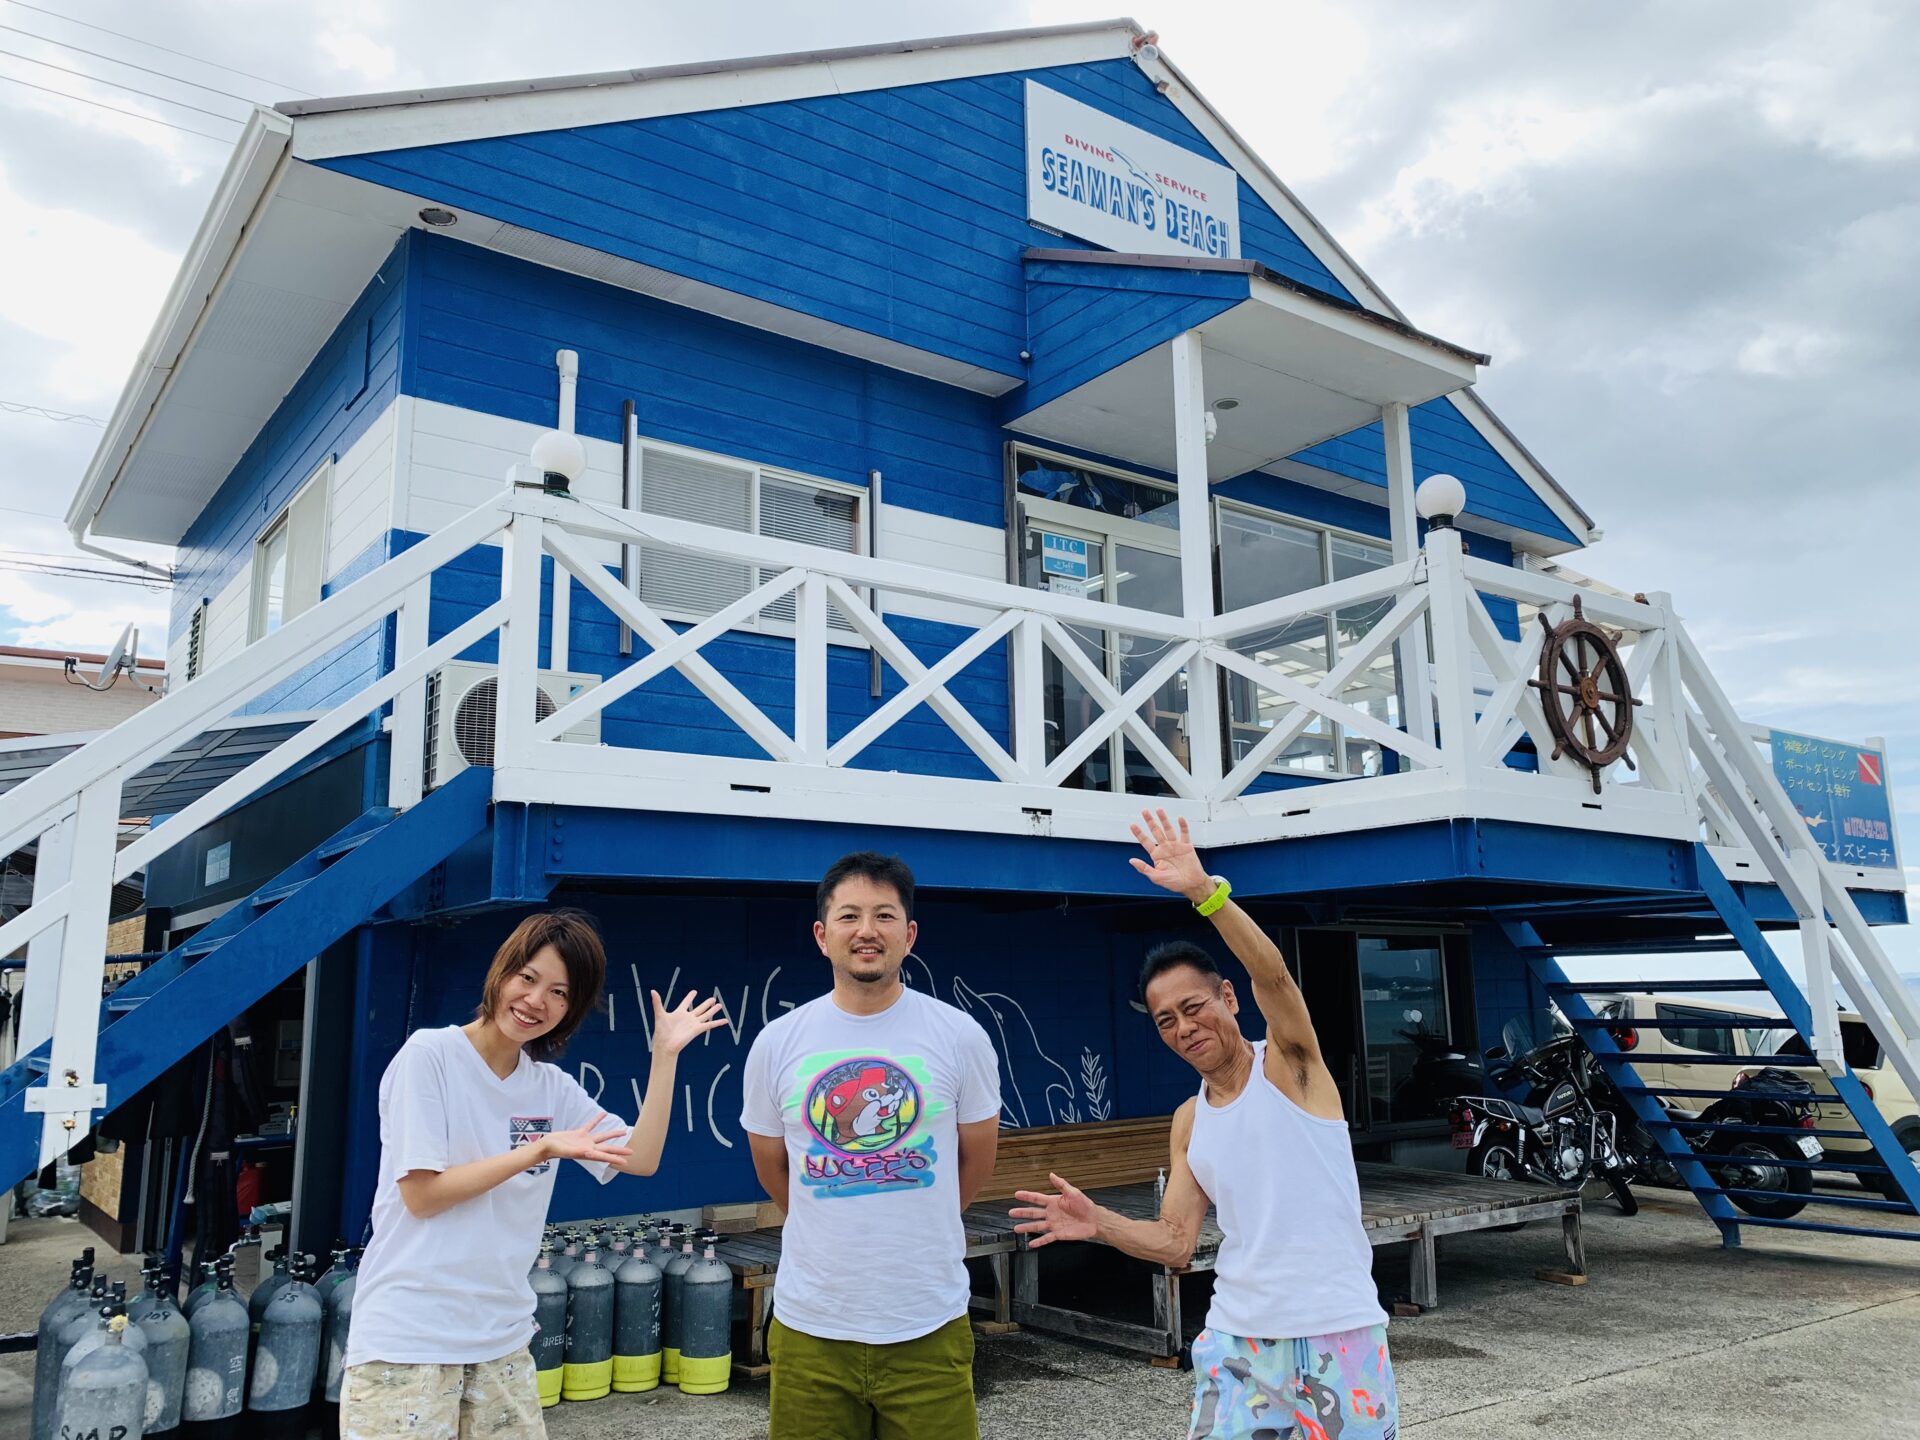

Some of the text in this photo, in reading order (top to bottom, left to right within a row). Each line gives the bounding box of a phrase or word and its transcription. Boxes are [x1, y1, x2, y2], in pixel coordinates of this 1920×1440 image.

[1042, 147, 1230, 258] SEAMAN'S BEACH
[1064, 134, 1207, 202] DIVING SERVICE
